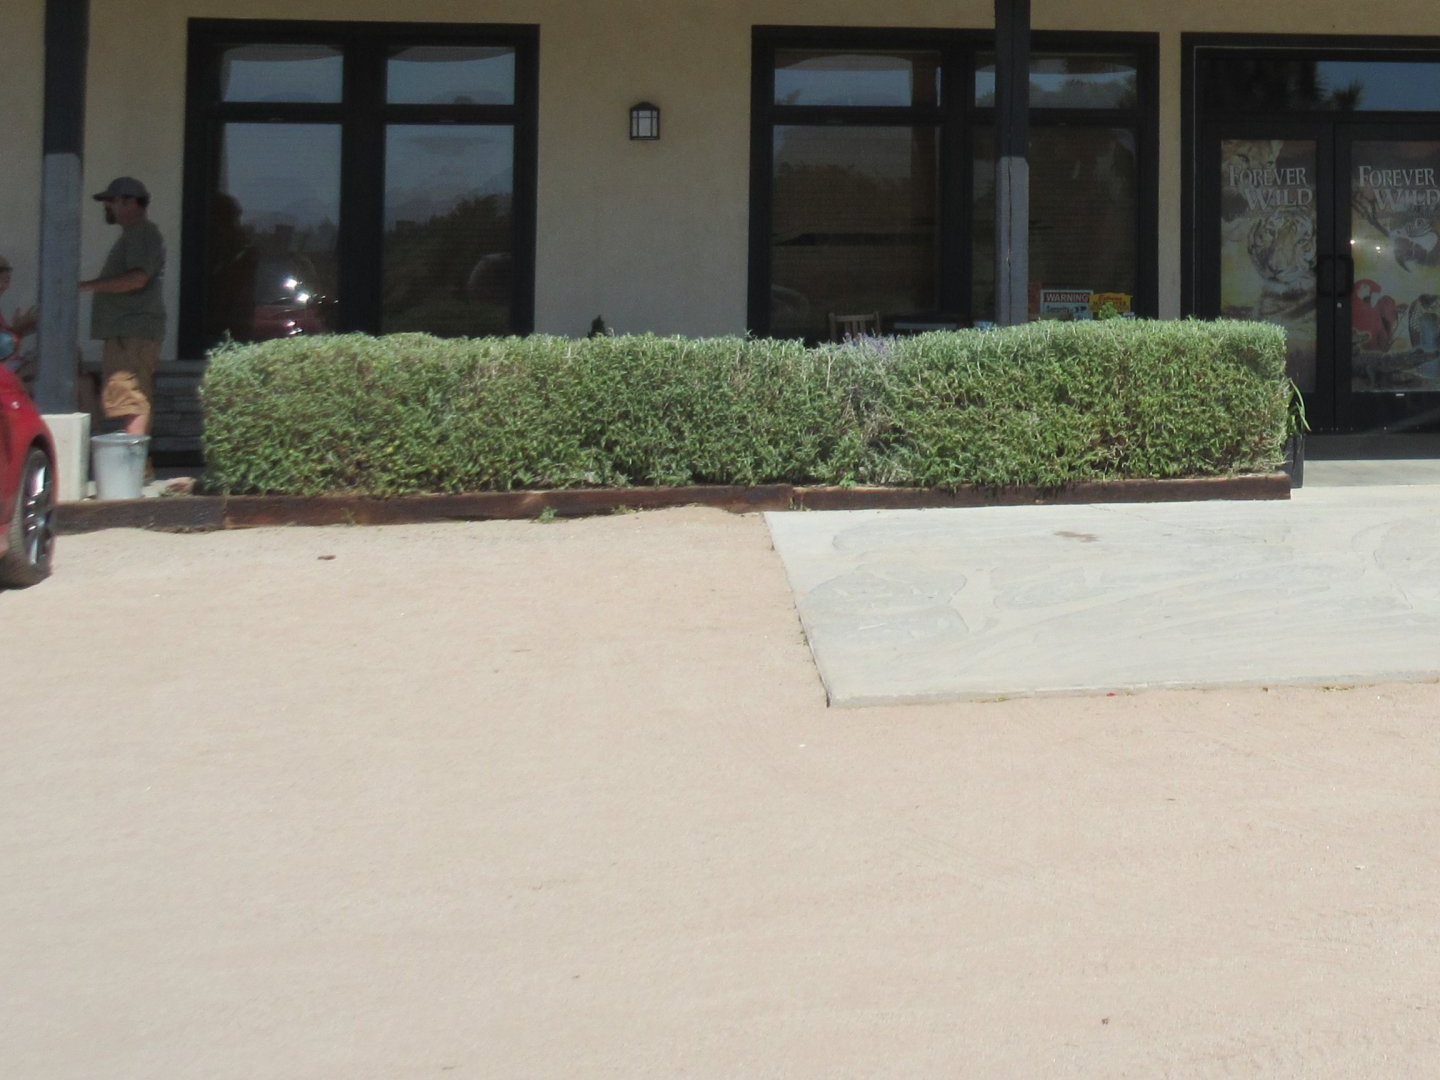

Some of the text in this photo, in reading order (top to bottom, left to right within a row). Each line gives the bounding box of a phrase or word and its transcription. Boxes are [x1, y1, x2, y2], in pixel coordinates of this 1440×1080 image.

[1228, 165, 1309, 188] FOREVER
[1358, 165, 1439, 188] FOREVER
[1244, 187, 1313, 210] WILD
[1046, 293, 1089, 303] WARNING
